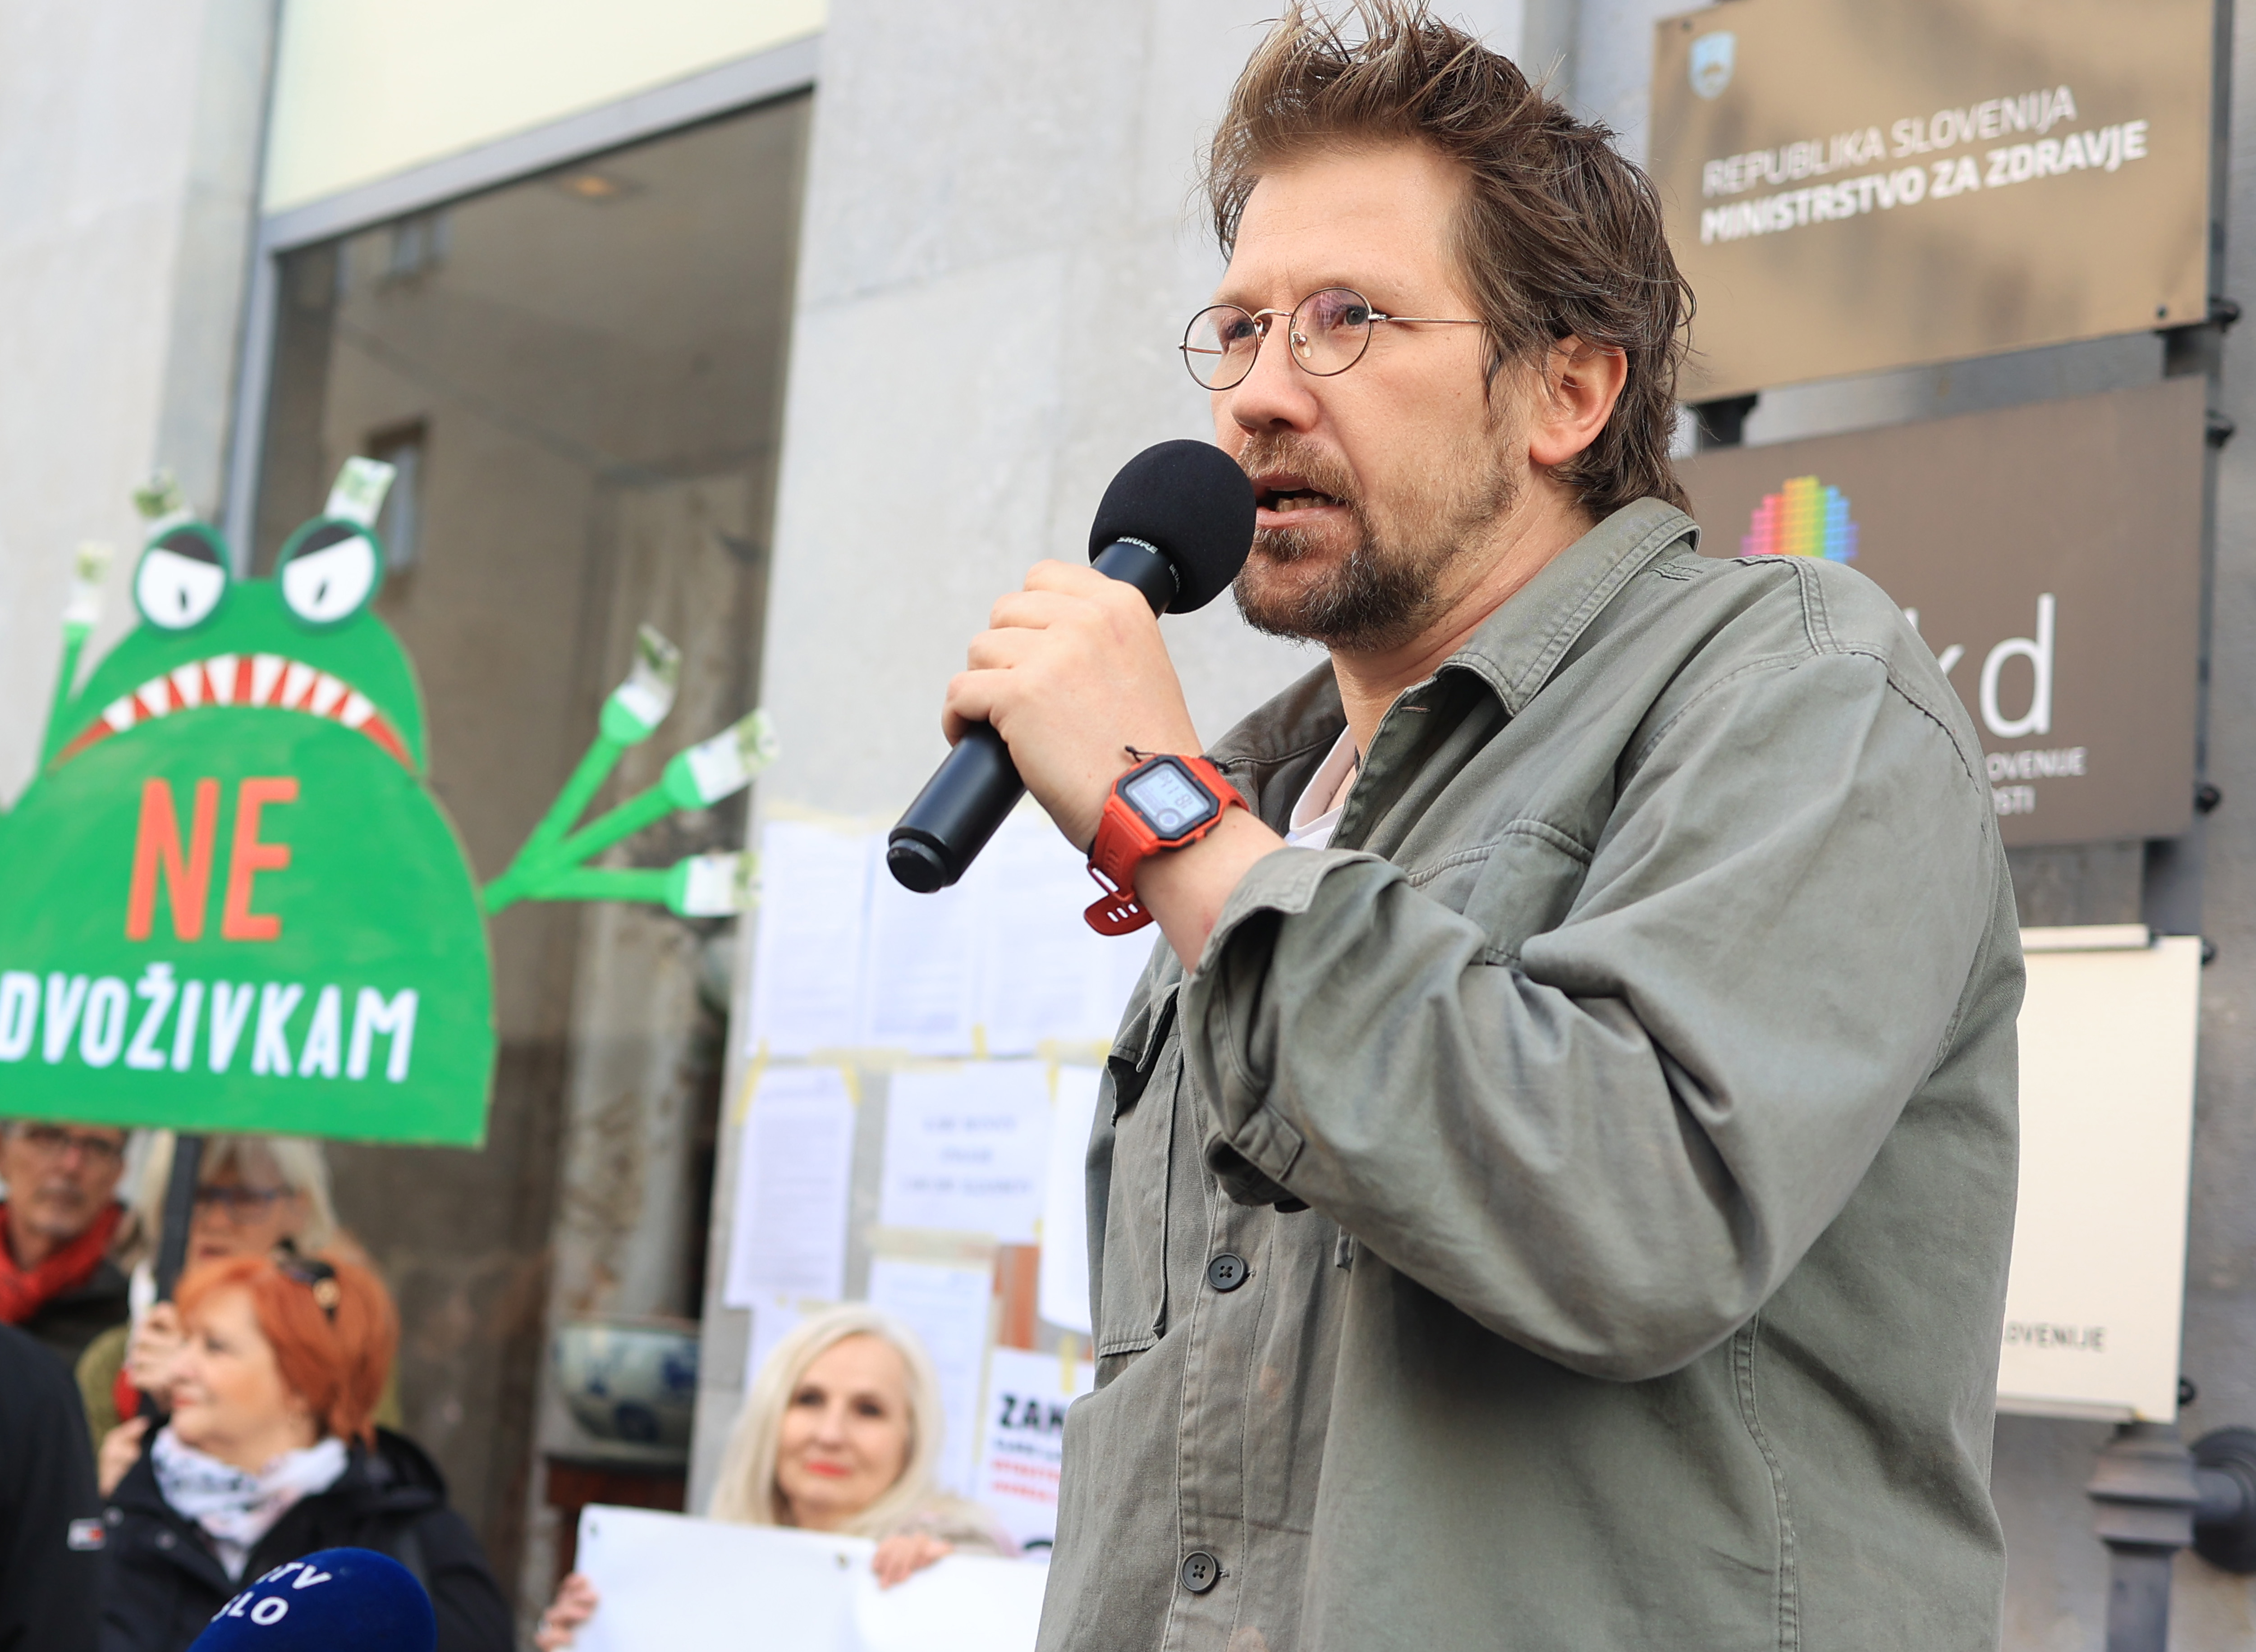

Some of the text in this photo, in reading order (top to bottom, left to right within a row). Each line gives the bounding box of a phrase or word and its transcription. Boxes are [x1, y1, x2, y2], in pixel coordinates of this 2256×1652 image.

[1700, 118, 2150, 246] MINISTRSTVO ZA ZDRAVJE
[1702, 84, 2077, 198] REPUBLIKA SLOVENIJA
[1116, 536, 1159, 554] SHURE
[1985, 746, 2088, 782] OVENIJE
[124, 776, 299, 942] NE
[0, 961, 419, 1084] DVOŽIVKAM
[2004, 1321, 2108, 1354] OVENIJE
